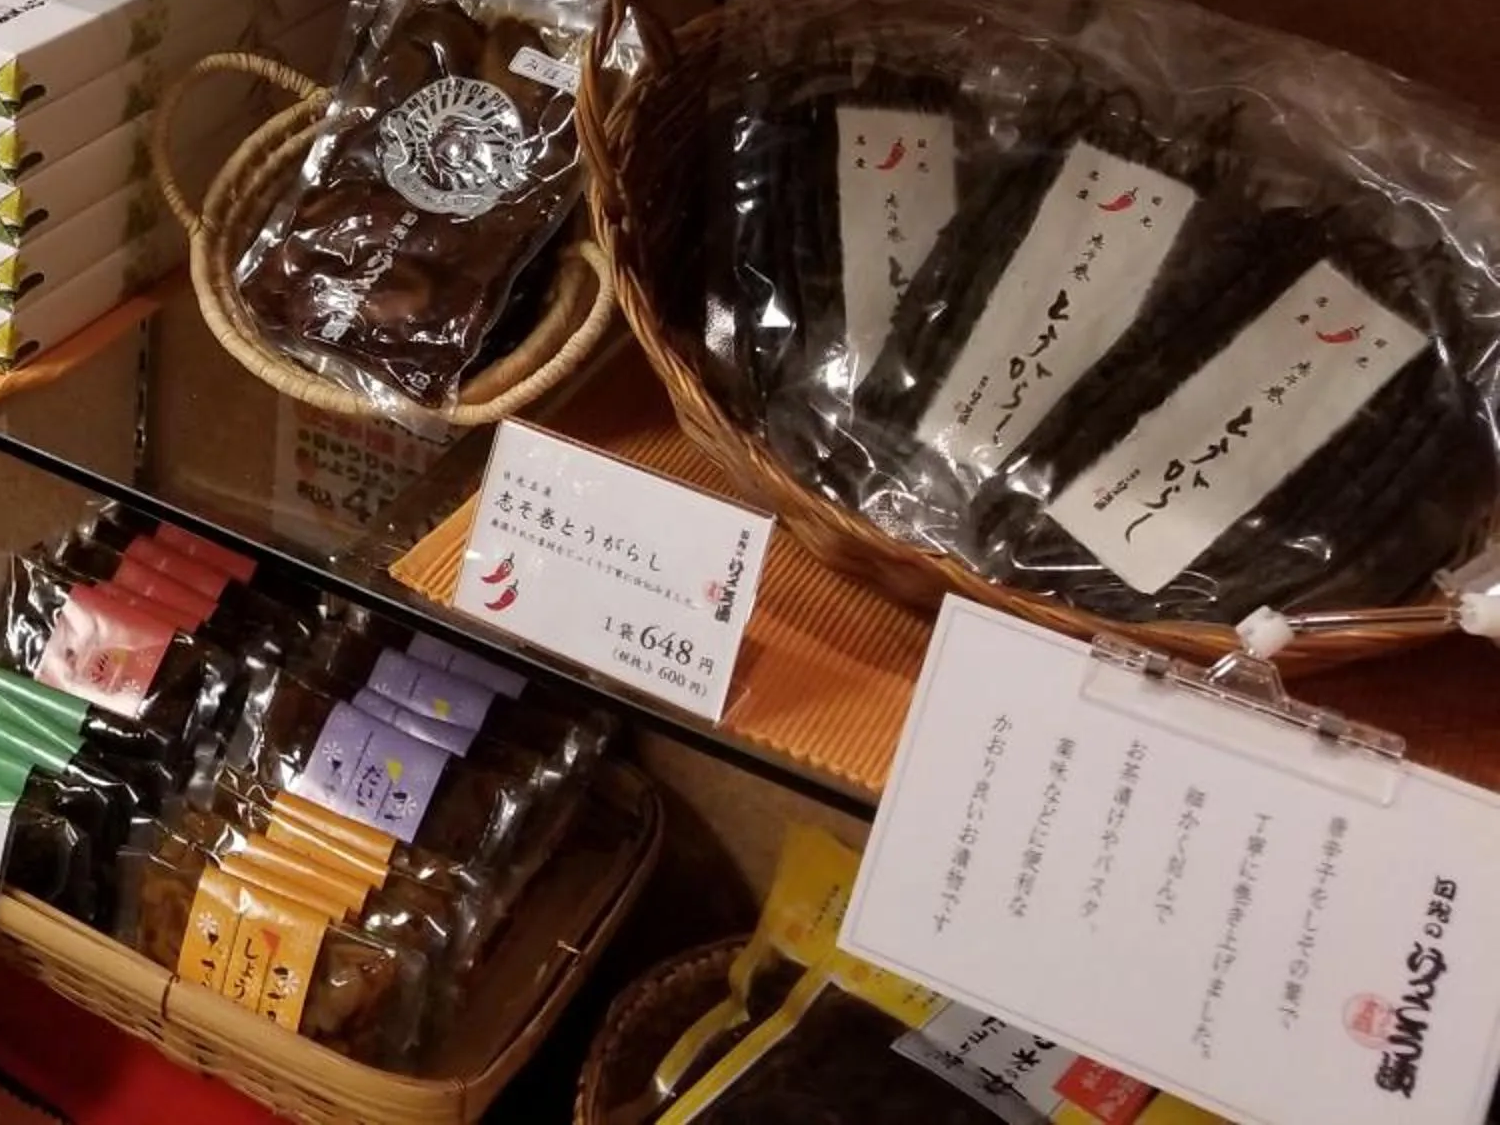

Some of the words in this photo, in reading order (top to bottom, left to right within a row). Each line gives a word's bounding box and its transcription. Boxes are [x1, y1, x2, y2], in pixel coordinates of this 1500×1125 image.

[495, 490, 661, 572] 志そ巻とうがらし
